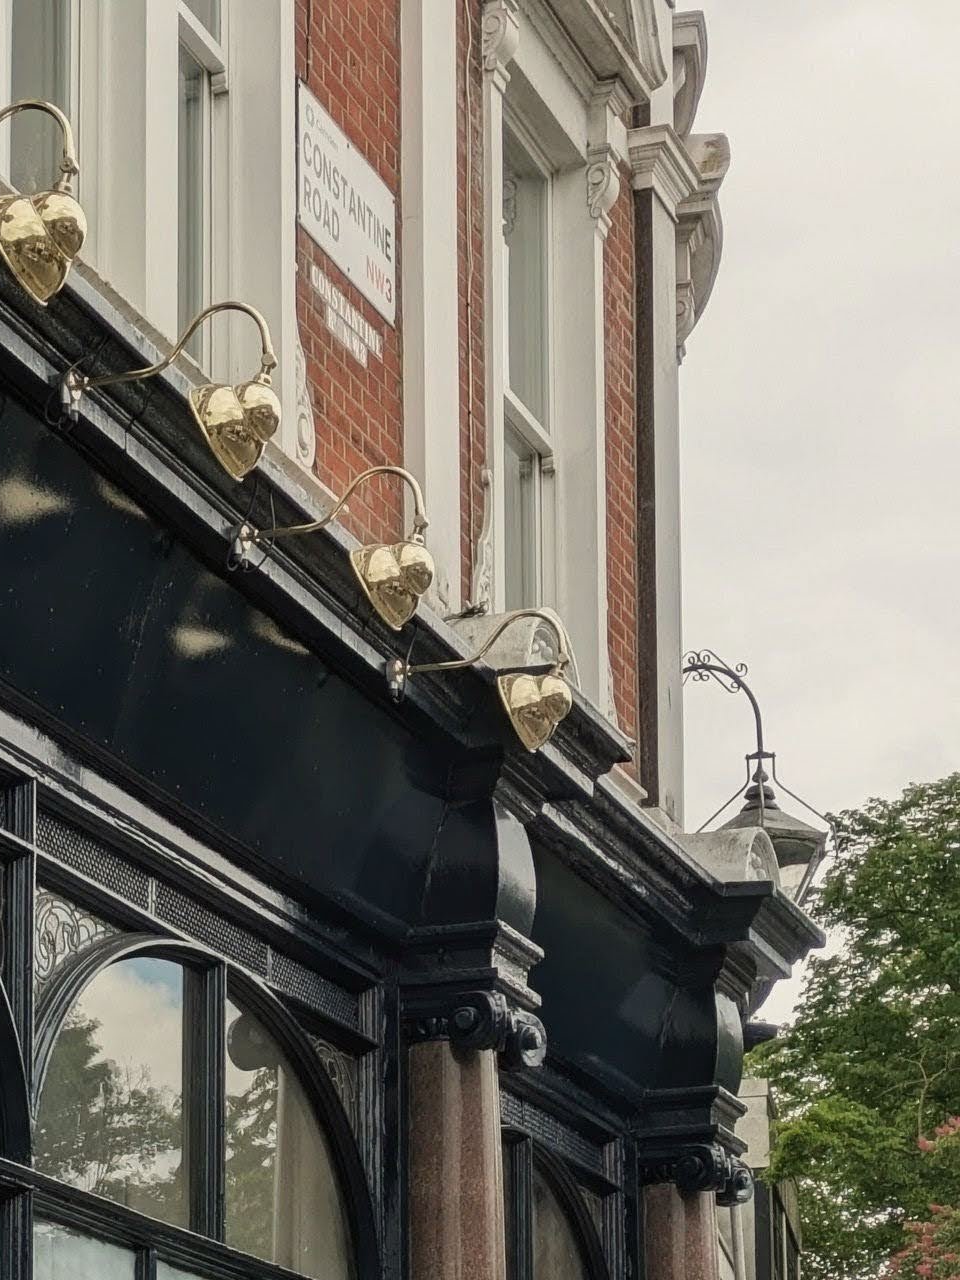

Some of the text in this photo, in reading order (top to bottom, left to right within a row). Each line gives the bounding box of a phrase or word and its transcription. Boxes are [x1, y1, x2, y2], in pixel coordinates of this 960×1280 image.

[303, 132, 392, 262] CONSTANTINE
[303, 176, 392, 303] ROAD NW3
[310, 264, 383, 362] CONSTANTINE
